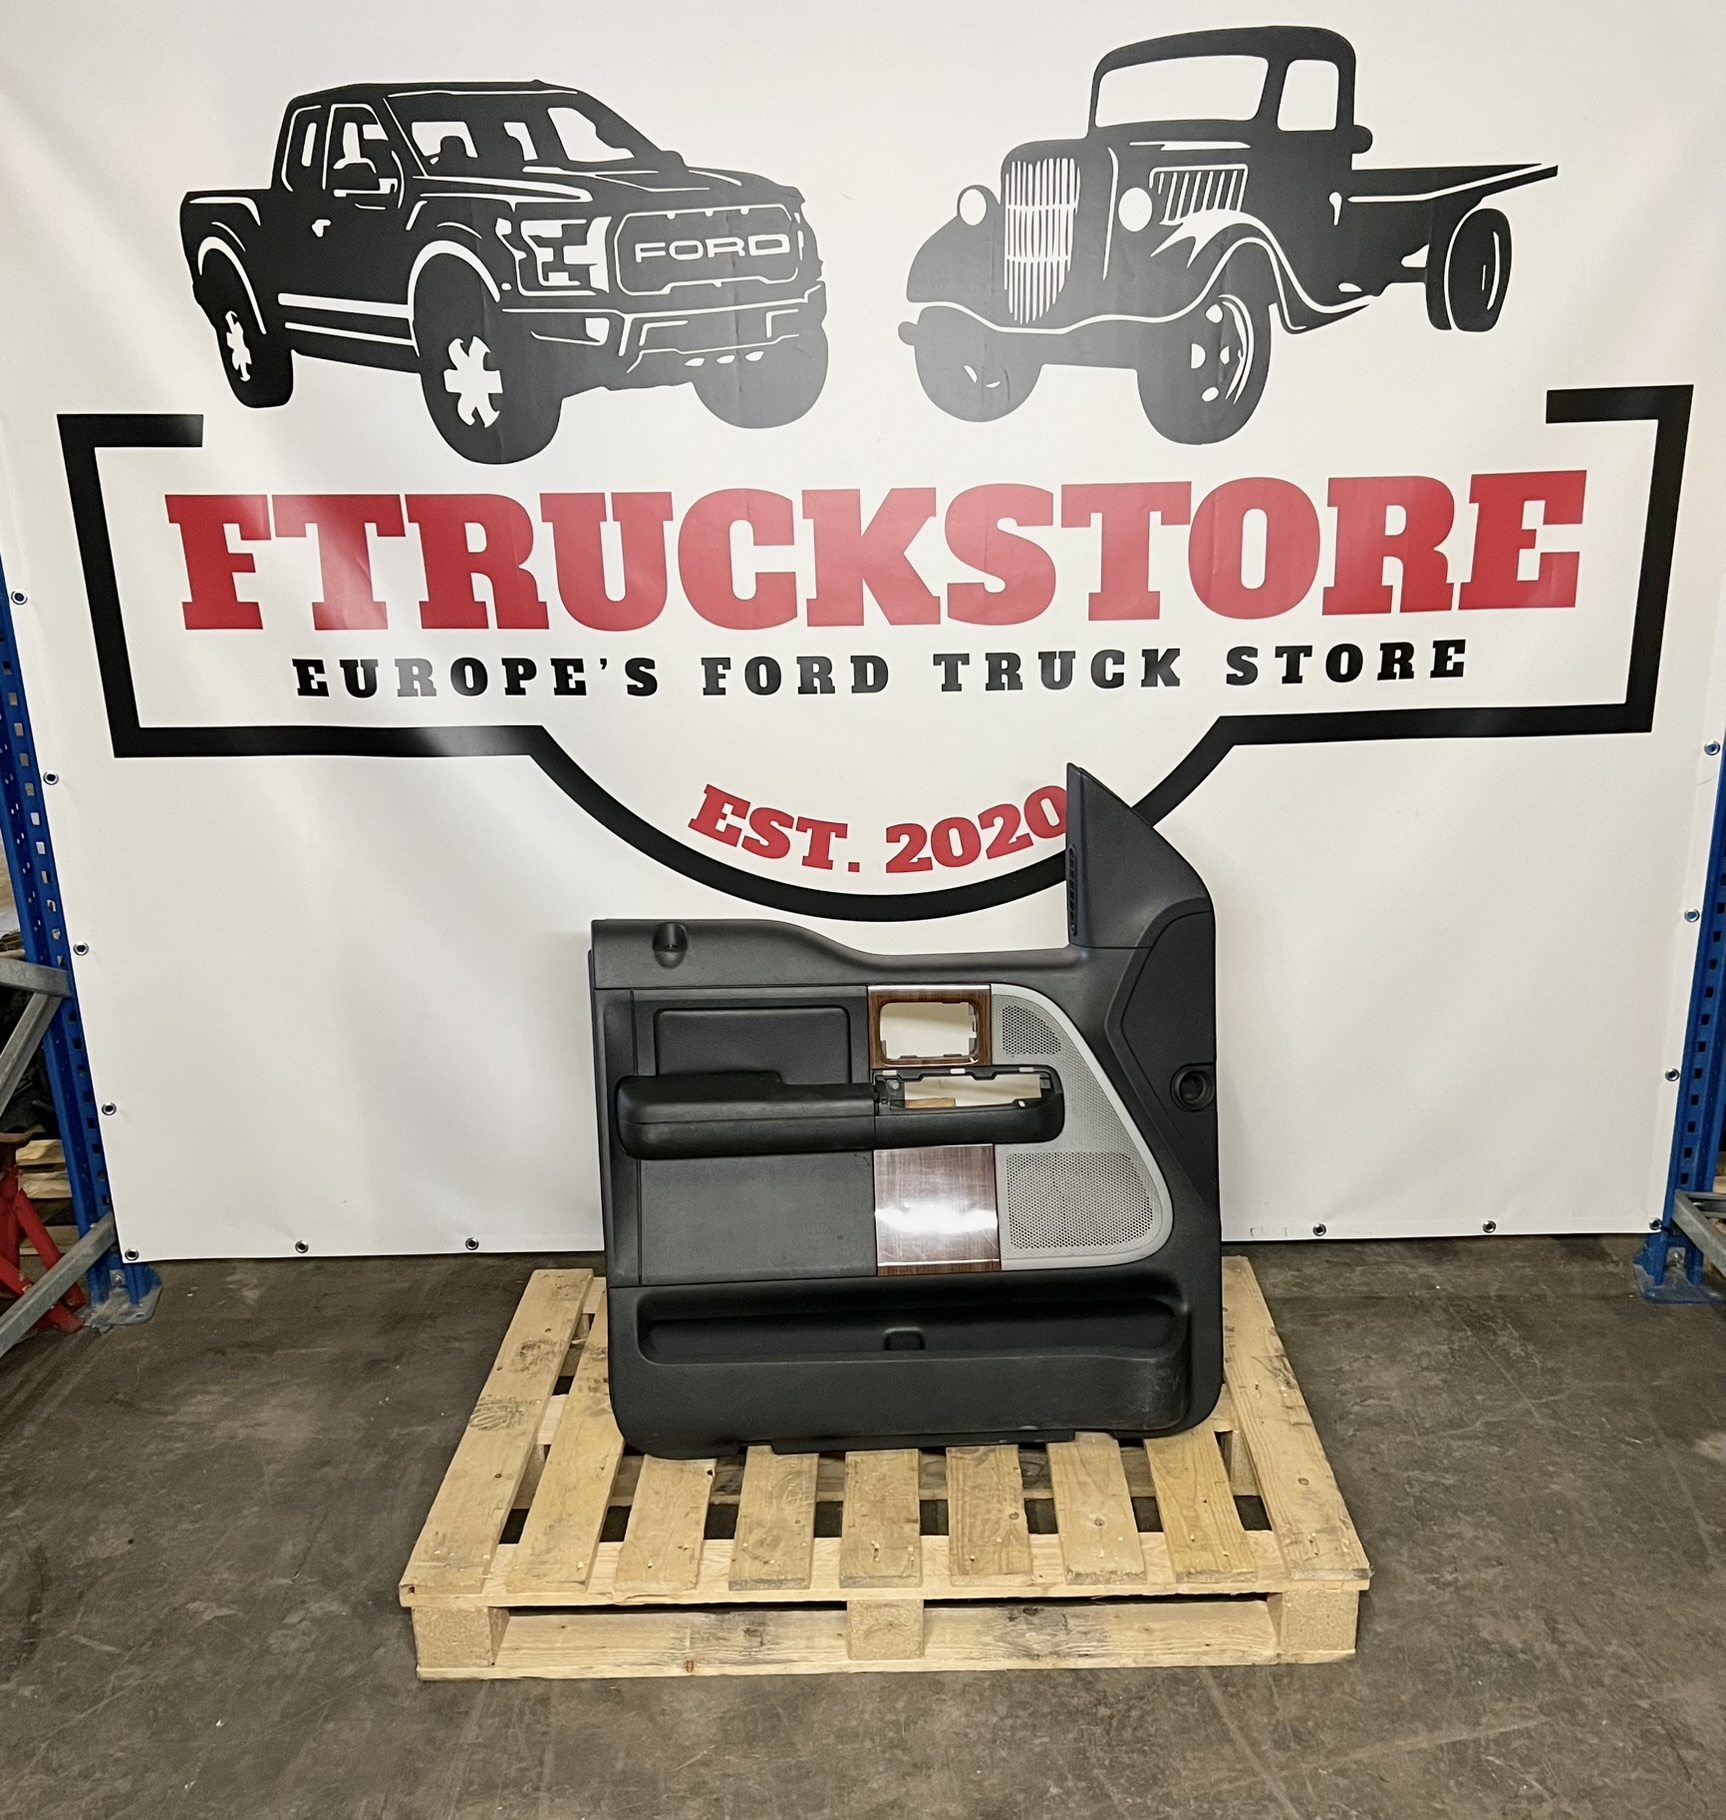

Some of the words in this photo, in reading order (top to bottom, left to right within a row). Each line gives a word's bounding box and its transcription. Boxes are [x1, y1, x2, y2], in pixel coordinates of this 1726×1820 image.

[634, 233, 791, 263] FORD
[166, 471, 1587, 631] FTRUCKSTORE
[291, 656, 658, 699] EUROPE'S
[700, 654, 889, 697] FORD
[932, 647, 1181, 694] TRUCK
[1225, 638, 1467, 686] STORE
[688, 784, 860, 874] EST.
[885, 785, 1067, 874] 2020
